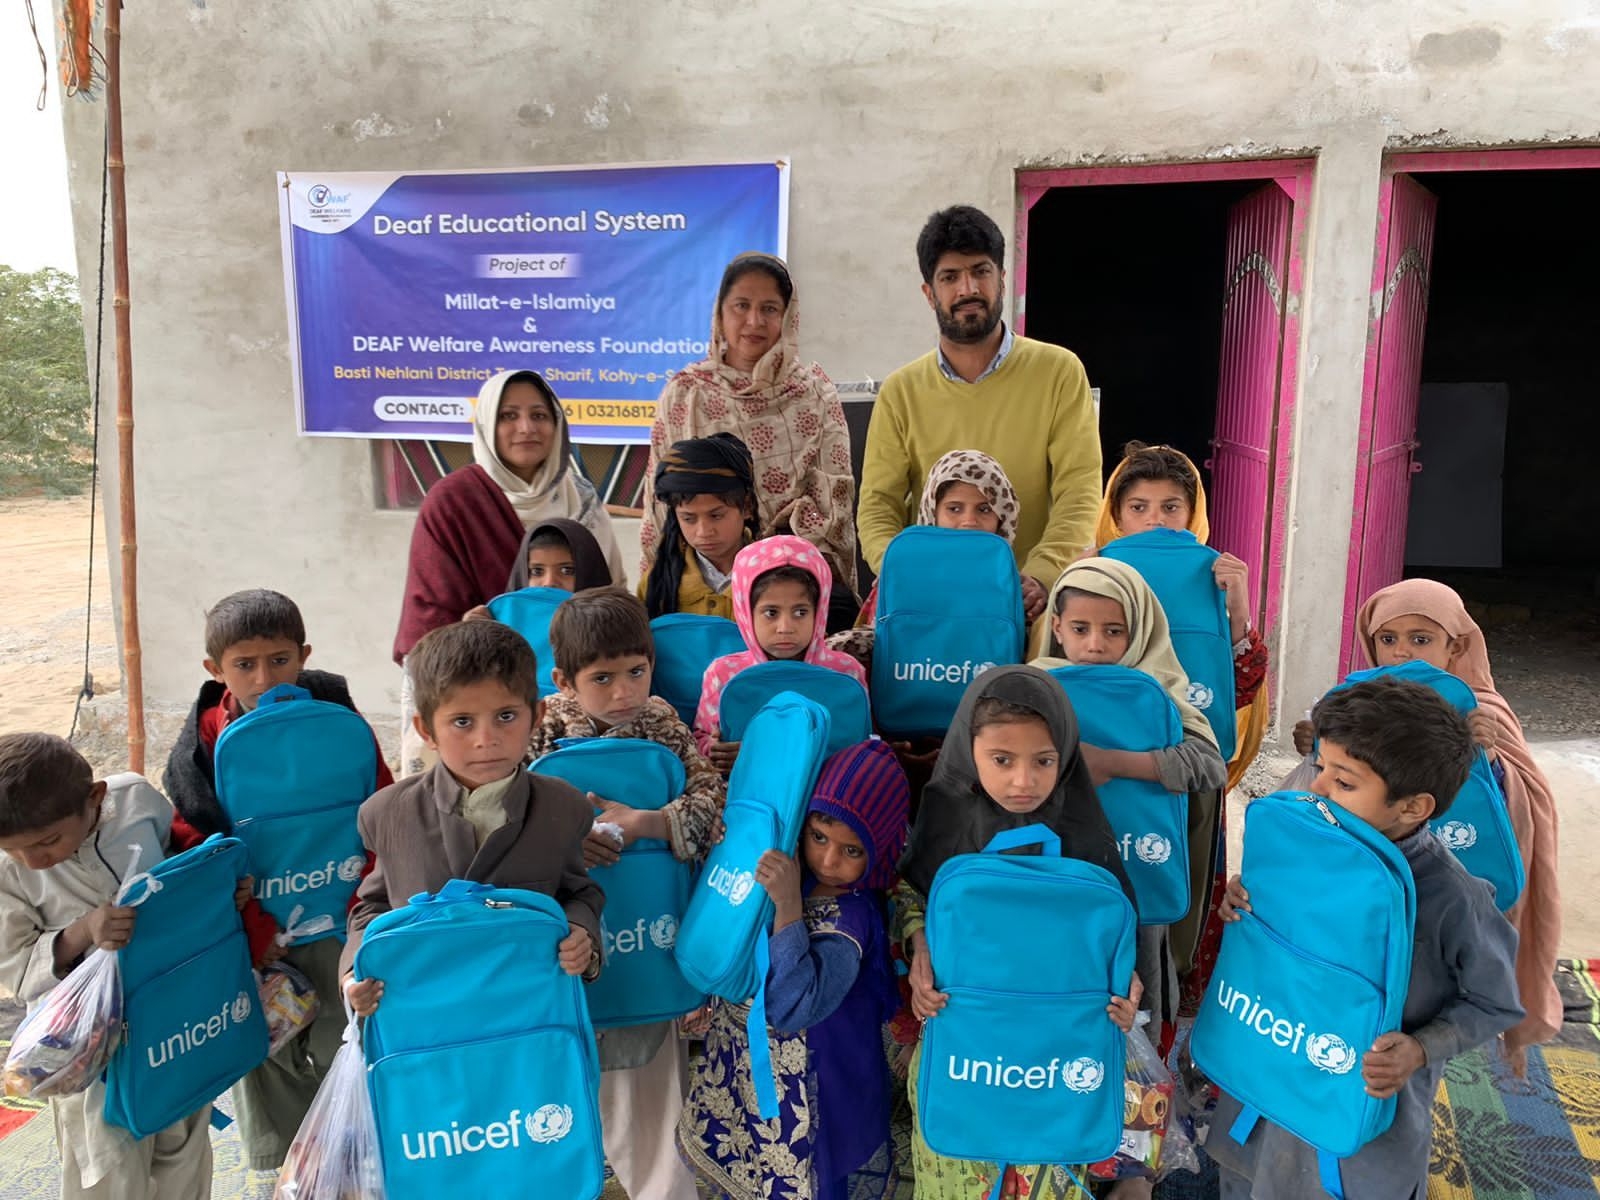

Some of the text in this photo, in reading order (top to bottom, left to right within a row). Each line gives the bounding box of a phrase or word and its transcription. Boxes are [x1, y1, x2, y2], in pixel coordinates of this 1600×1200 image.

[374, 209, 686, 237] Deaf Educational System
[488, 256, 567, 274] Project of
[445, 292, 616, 313] Millat-e-Islamiya
[522, 317, 538, 333] &
[352, 335, 404, 352] DEAF
[408, 335, 485, 352] Welfare
[489, 336, 595, 353] Awareness
[333, 365, 371, 380] Basti
[375, 365, 433, 380] Nehlani
[437, 366, 491, 381] District
[545, 367, 595, 384] Sharif,
[598, 367, 677, 386] Kohy-e-S
[384, 402, 464, 416] CONTACT:
[586, 404, 657, 418] 03216812
[894, 657, 972, 684] unicef
[1217, 979, 1306, 1055] unicef
[147, 1001, 229, 1068] unicef
[948, 1055, 1060, 1089] unicef
[401, 1109, 522, 1161] unicef
